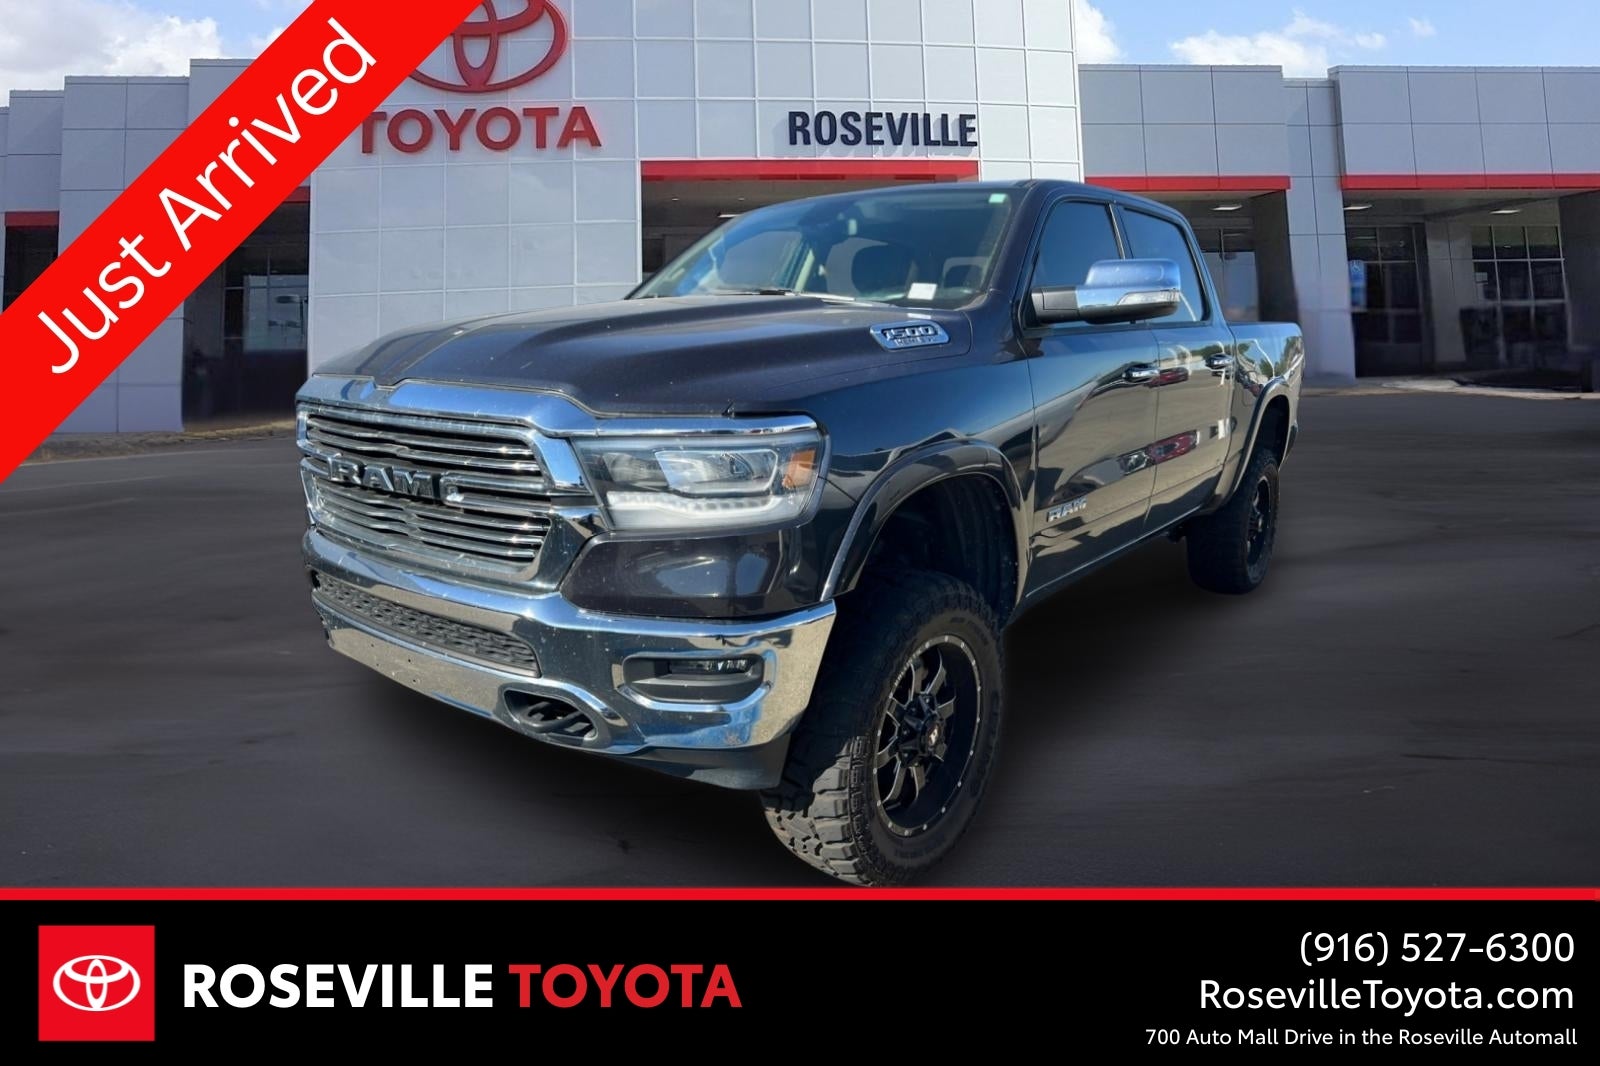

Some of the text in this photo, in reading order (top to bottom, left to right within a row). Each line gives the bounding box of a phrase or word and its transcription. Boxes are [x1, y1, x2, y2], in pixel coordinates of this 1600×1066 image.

[361, 106, 602, 153] TOYOTA
[788, 111, 978, 146] ROSEVILLE
[882, 325, 935, 341] 1500
[328, 453, 435, 498] RAM
[1047, 496, 1087, 521] RAM
